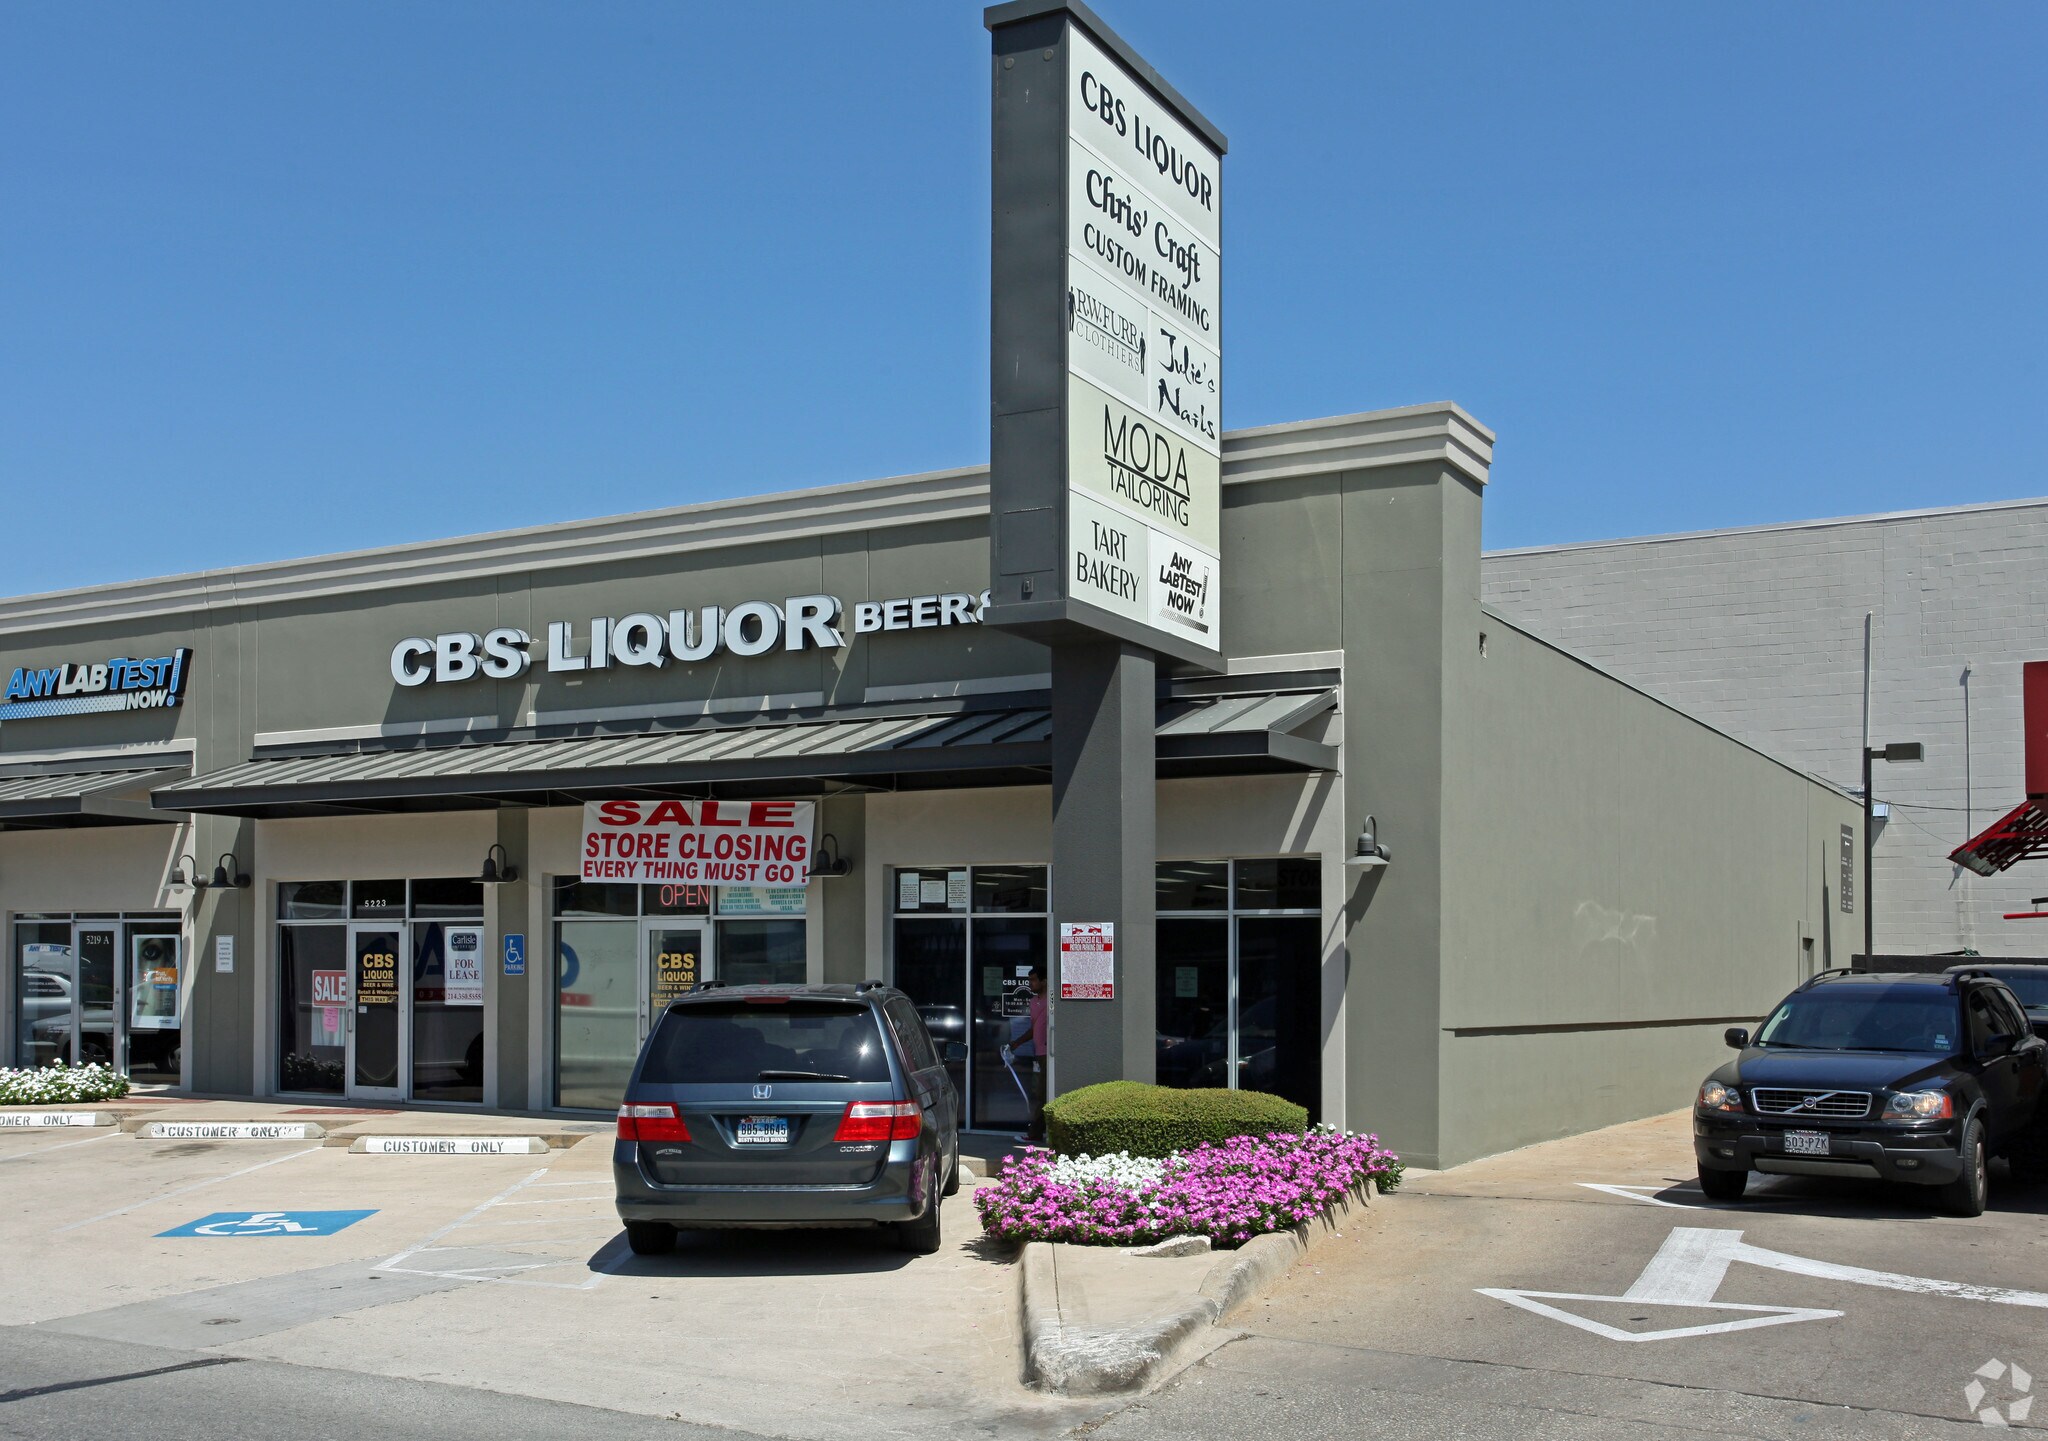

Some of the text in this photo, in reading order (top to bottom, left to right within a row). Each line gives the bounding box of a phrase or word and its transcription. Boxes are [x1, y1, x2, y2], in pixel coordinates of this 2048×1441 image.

[1080, 71, 1212, 212] CBS LIQUOR
[1154, 221, 1201, 289] Craft
[1084, 223, 1210, 332] CUSTOM FRAMING
[1076, 321, 1140, 372] CLOTHIERS
[1158, 328, 1215, 393] Julie's
[1158, 378, 1216, 440] Nails
[1104, 404, 1190, 496] MODA
[1107, 461, 1189, 527] TAILORING
[1091, 520, 1127, 562] TART
[1170, 552, 1192, 575] ANY
[1077, 551, 1140, 602] BAKERY
[390, 627, 530, 688] CBS
[547, 593, 845, 673] LIQUOR
[854, 591, 974, 633] BEER
[598, 801, 796, 828] SALE
[585, 832, 807, 862] STORE CLOSING
[583, 860, 638, 878] EVERY
[643, 862, 698, 880] THING
[704, 863, 759, 882] MUST
[764, 864, 794, 883] GO
[364, 900, 387, 908] 5223
[660, 884, 709, 906] OPEN
[86, 936, 110, 944] 5219 A
[452, 935, 476, 945] Carlisle
[363, 953, 394, 968] CBS
[455, 959, 474, 968] FOR
[658, 953, 694, 969] CBS
[363, 970, 394, 980] LIQUOR
[449, 970, 480, 980] LEASE
[657, 971, 694, 982] LIQUOR
[314, 976, 347, 1002] SALE
[44, 1115, 73, 1125] ONLY
[168, 1126, 281, 1137] CUSTOMER ONLY
[383, 1140, 504, 1153] CUSTOMER ONLY
[840, 1144, 878, 1152] ODYSSEY
